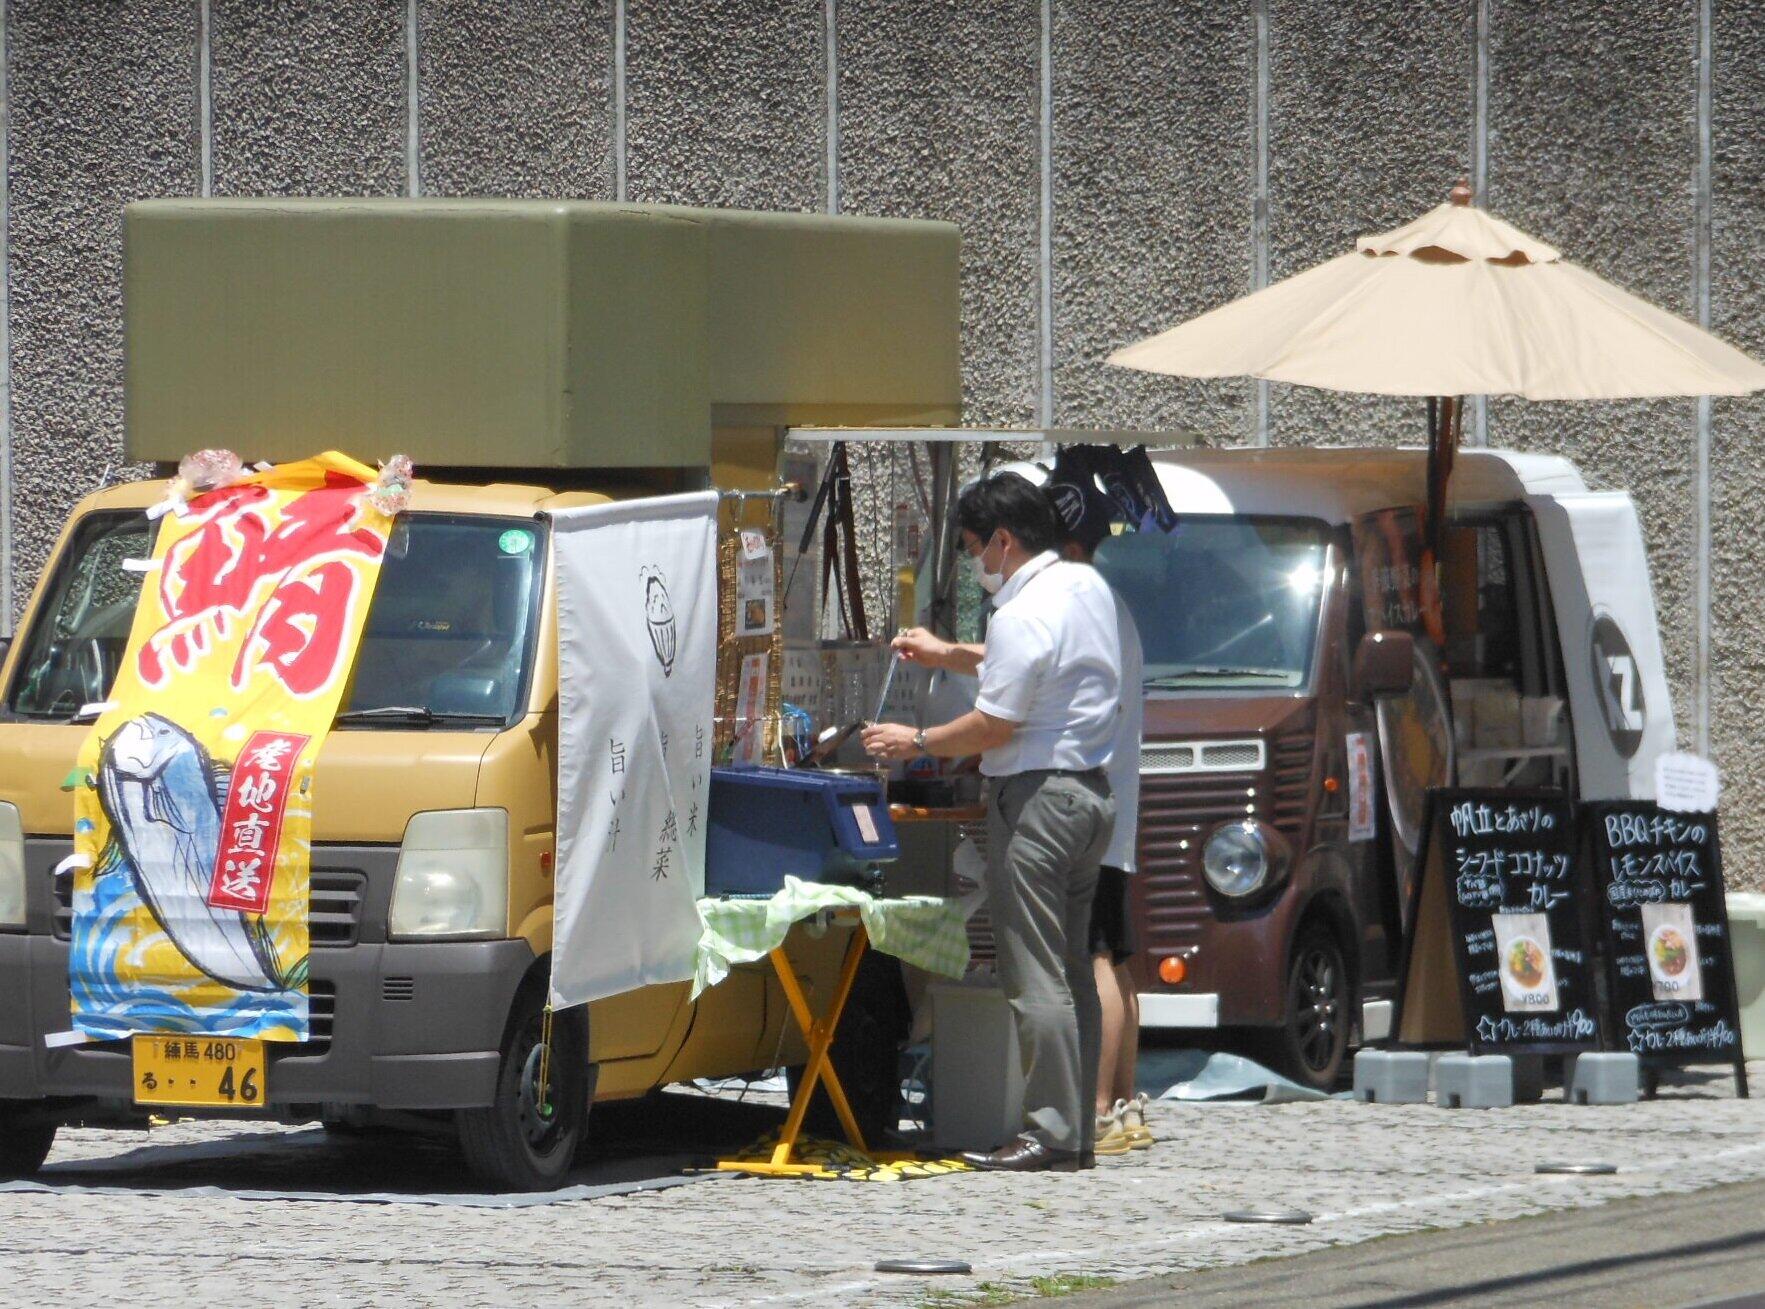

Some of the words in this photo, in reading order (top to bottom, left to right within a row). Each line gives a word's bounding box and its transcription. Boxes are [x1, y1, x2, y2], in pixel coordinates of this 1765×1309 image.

[138, 470, 384, 698] 鯖
[220, 738, 292, 902] 産地直送
[1526, 882, 1569, 909] カレー
[204, 1042, 236, 1061] 480
